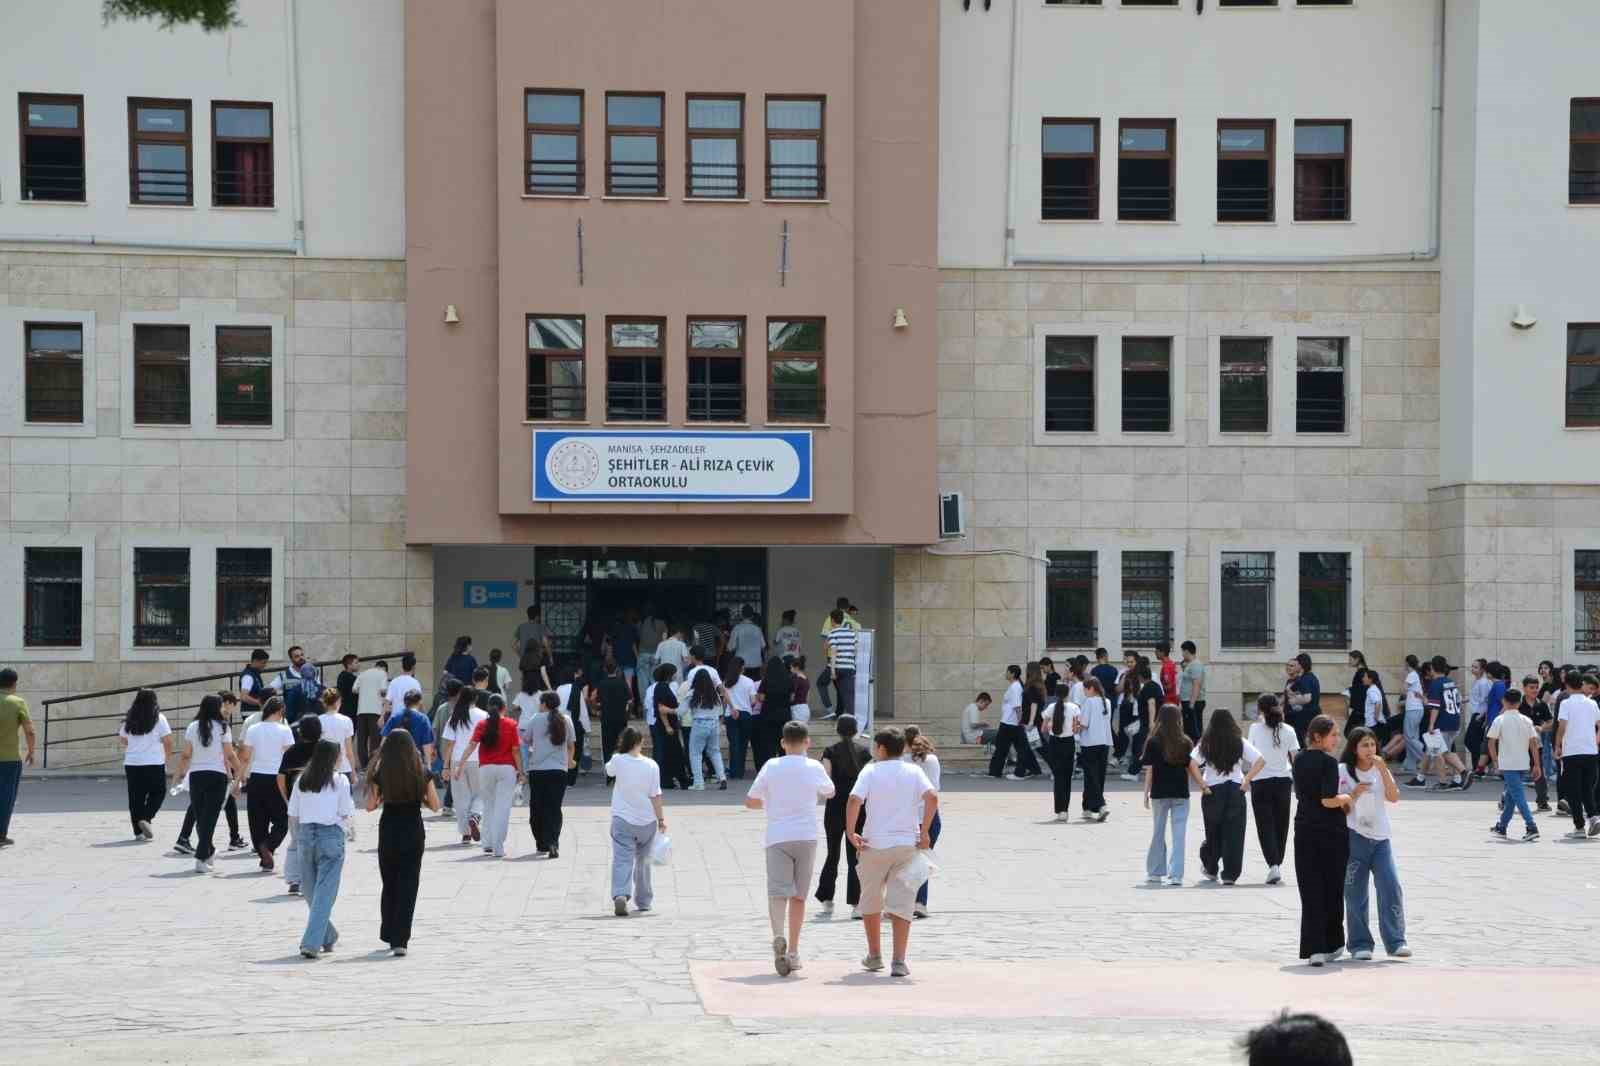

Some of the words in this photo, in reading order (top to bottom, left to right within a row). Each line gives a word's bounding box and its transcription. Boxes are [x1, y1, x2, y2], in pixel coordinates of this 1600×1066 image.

[608, 444, 642, 454] MANİSA
[651, 445, 706, 455] ŞEHZADELER
[608, 457, 669, 473] ŞEHİTLER
[679, 456, 700, 471] ALİ
[703, 459, 733, 471] RIZA
[736, 456, 775, 474] ÇEVİK
[608, 476, 688, 488] ORTAOKULU
[471, 585, 488, 604] B
